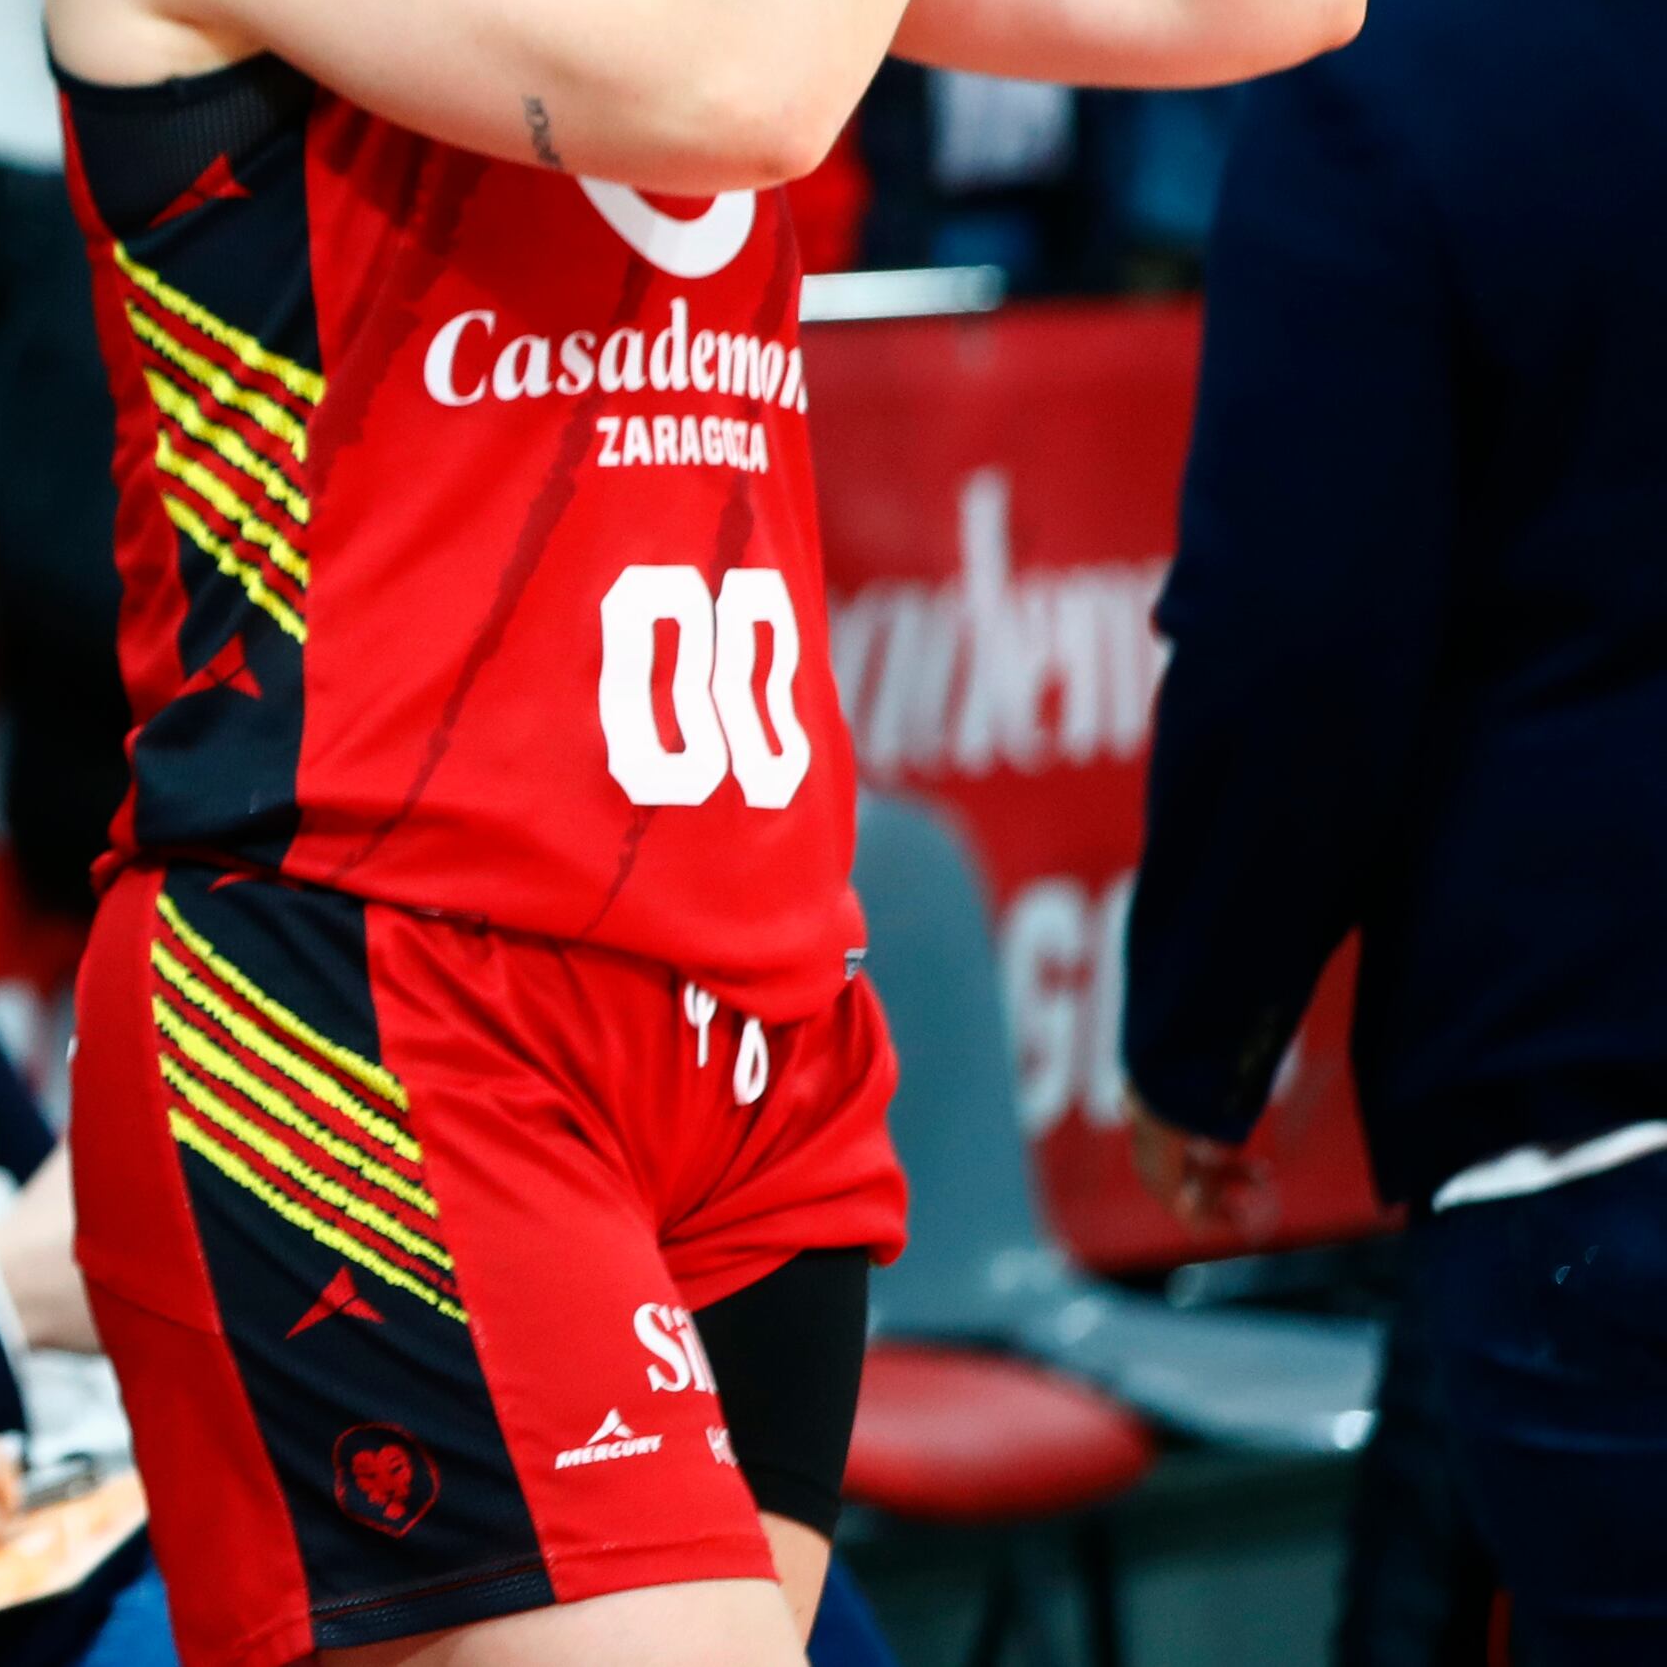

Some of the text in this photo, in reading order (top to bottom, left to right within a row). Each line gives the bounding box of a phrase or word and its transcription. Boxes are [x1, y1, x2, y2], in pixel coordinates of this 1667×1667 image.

[595, 415, 769, 474] ZARAGOZA
[598, 563, 812, 810] 00
[554, 1434, 663, 1471] MERCURY
